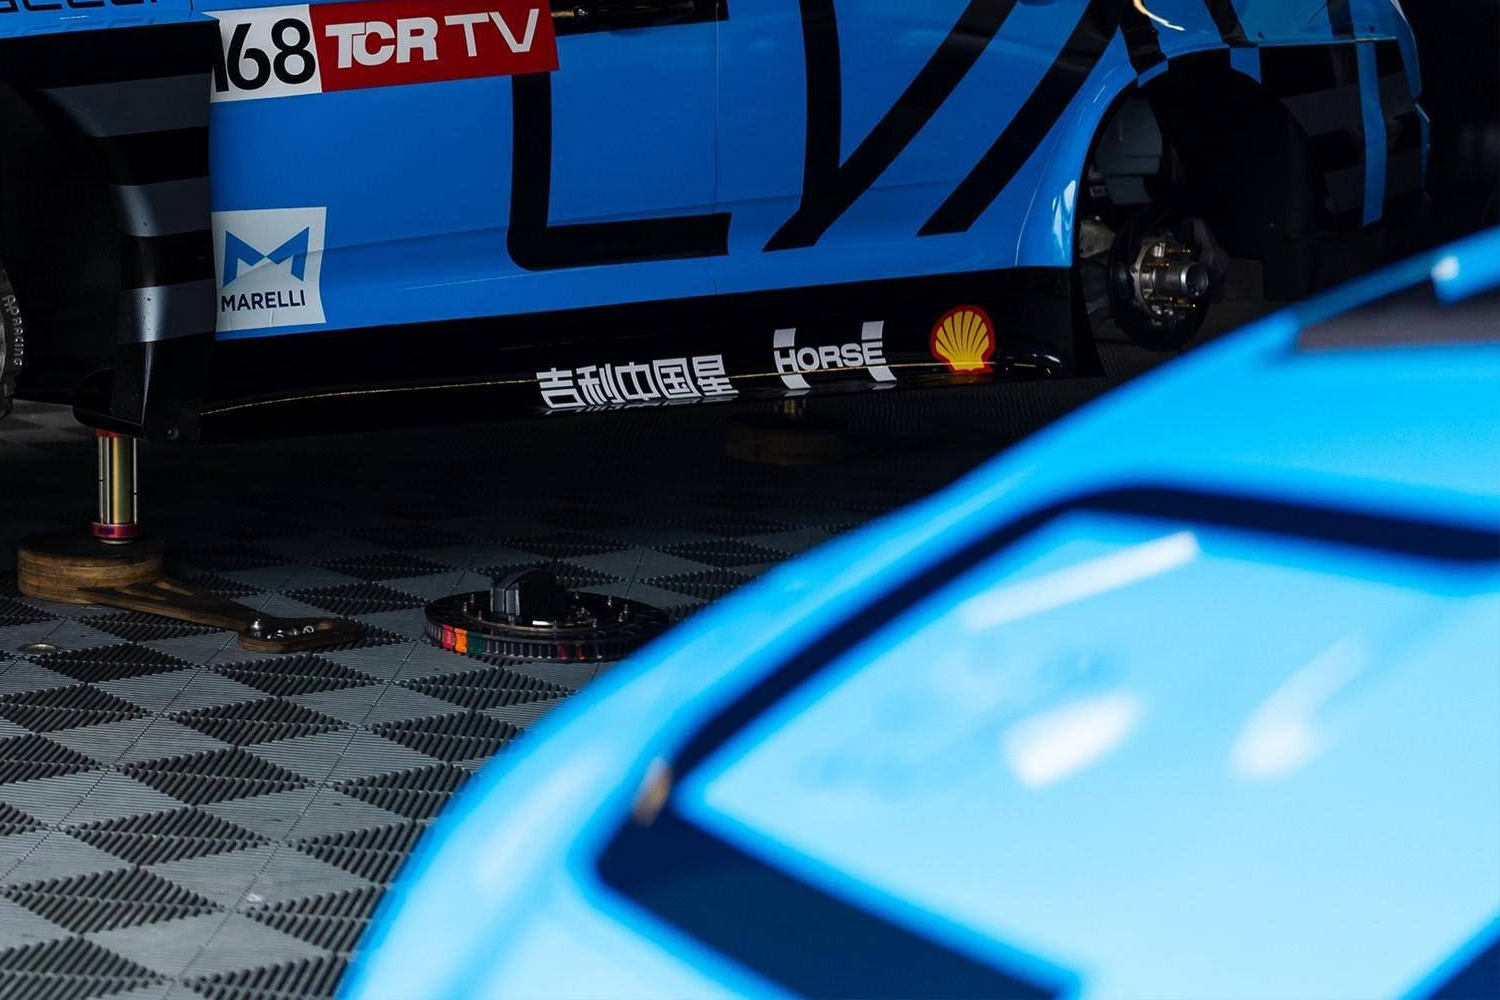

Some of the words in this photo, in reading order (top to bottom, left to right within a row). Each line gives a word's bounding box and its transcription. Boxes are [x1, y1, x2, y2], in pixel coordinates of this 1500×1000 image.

[325, 16, 439, 69] TCR
[445, 8, 540, 57] TV
[221, 289, 306, 312] MARELLI
[535, 354, 740, 408] 吉利中国星
